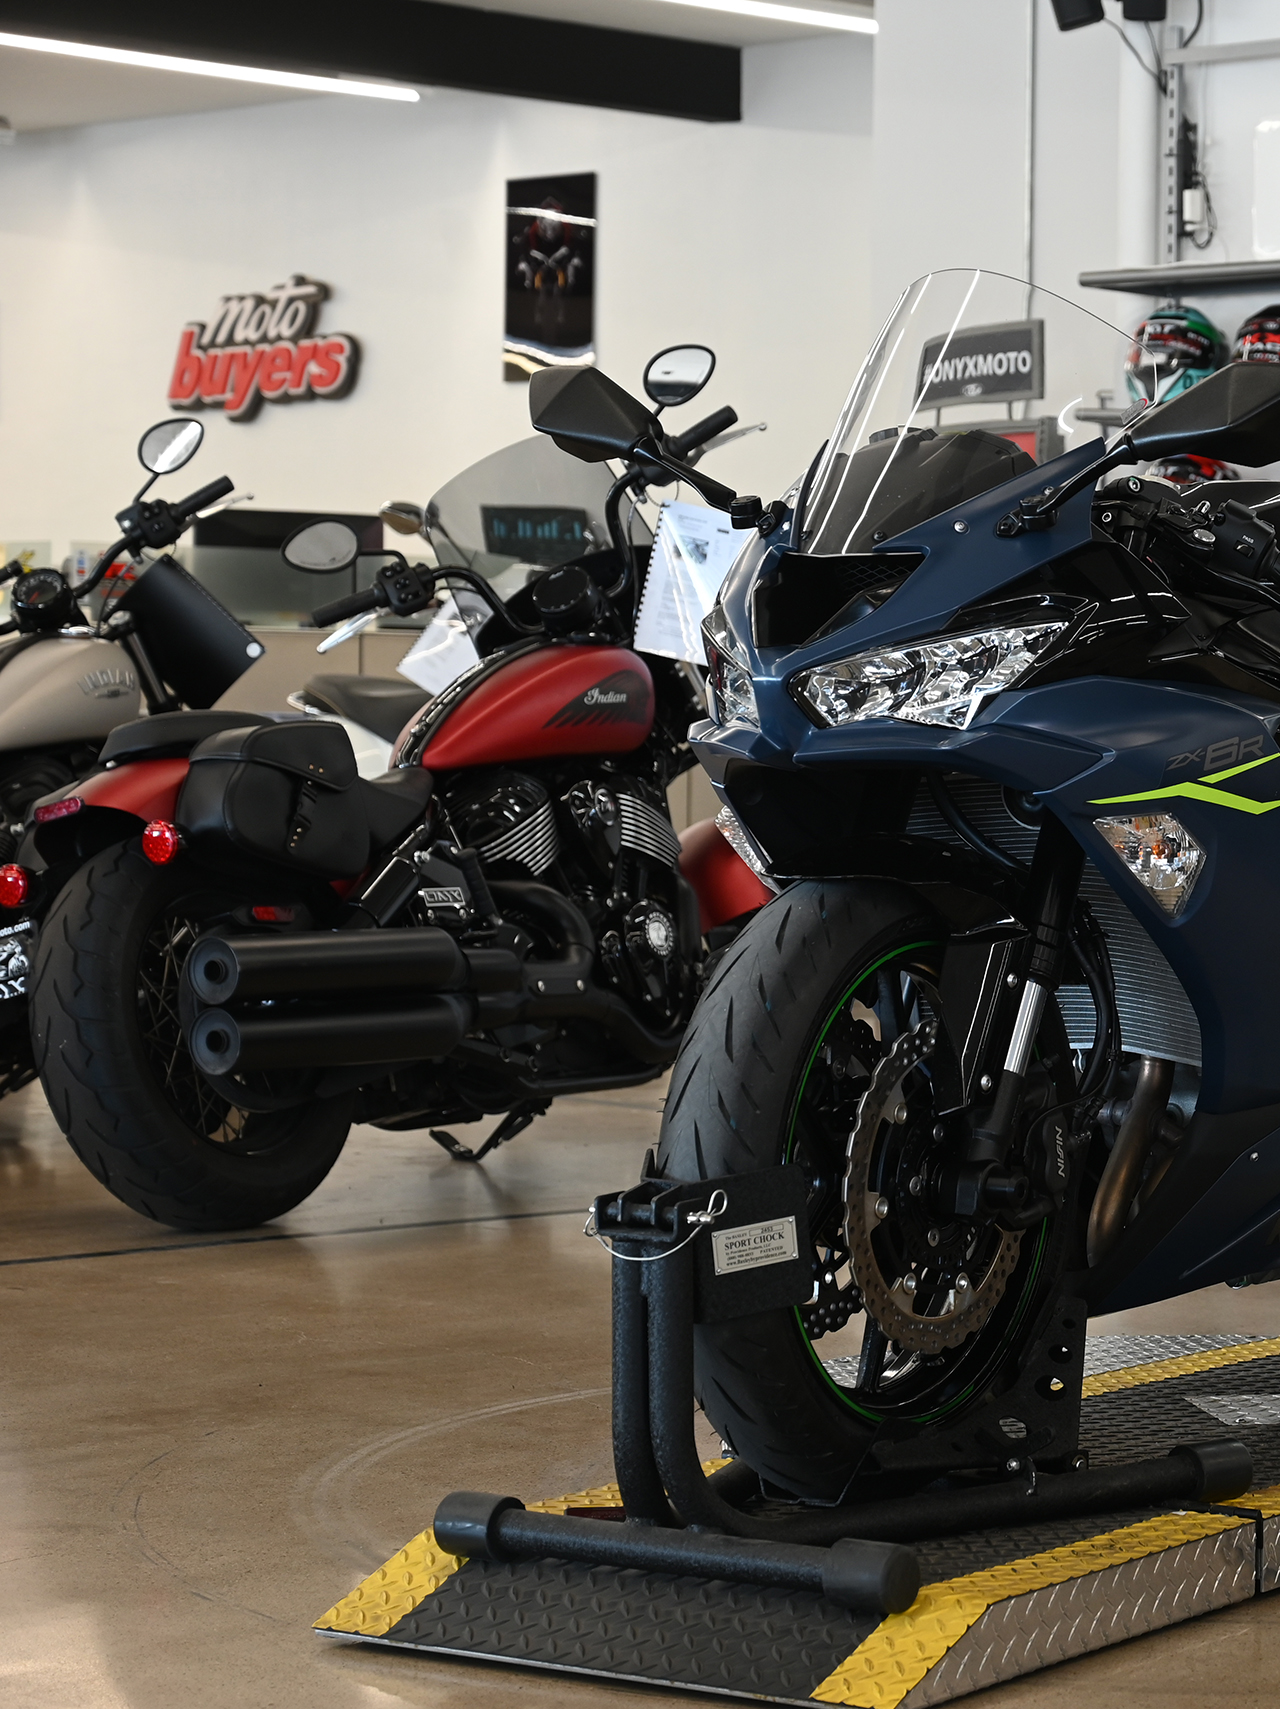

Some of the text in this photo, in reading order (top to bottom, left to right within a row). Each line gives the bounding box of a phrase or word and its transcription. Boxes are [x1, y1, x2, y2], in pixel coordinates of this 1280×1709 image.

[167, 325, 348, 413] buyers
[584, 687, 628, 705] Indian
[1165, 735, 1264, 771] ZX-6R
[1054, 1125, 1066, 1178] NISSIN
[724, 1231, 785, 1251] SPORT CHOCK
